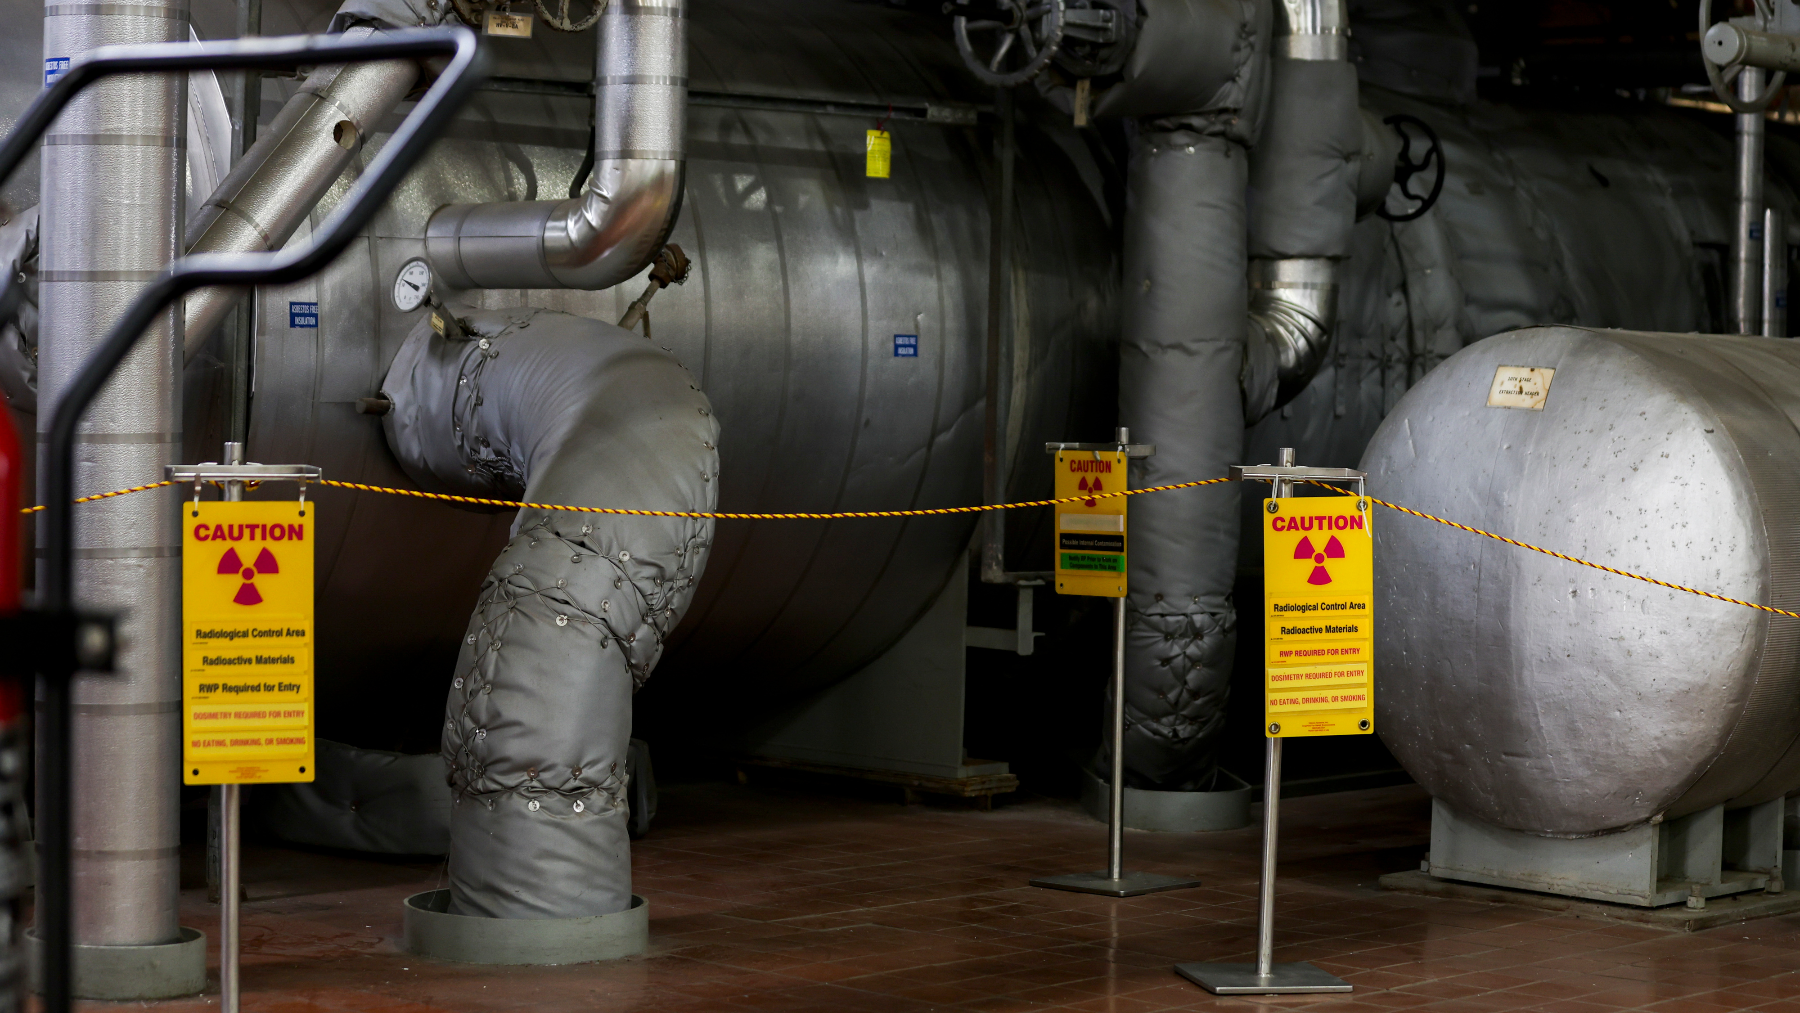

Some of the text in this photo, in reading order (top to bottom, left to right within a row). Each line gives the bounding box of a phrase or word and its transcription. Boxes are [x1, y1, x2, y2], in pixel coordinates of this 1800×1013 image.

[292, 305, 318, 314] ASBESTOS FREE
[295, 317, 316, 325] INSULATION
[1070, 460, 1111, 473] CAUTION
[1272, 515, 1363, 532] CAUTION
[194, 523, 304, 541] CAUTION
[1274, 601, 1366, 613] Radiological Control Area
[196, 628, 305, 641] Radiological Control Area
[1281, 625, 1359, 635] Radioactive Materials
[1279, 648, 1361, 658] RWP REQUIRED FOR ENTRY
[202, 655, 295, 666] Radioactive Materials
[1271, 669, 1365, 682] DOSIMETRY REQUIRED FOR ENTRY
[199, 682, 300, 694] RWP Required for Entry
[1270, 694, 1366, 706] NO EATING, DRINKING, OR SMOKING
[193, 709, 305, 720] DOSIMETRY REQUIRED FOR ENTRY
[192, 739, 202, 748] NO
[203, 739, 228, 748] EATING,
[265, 738, 274, 746] OR
[276, 737, 306, 746] SMOKING
